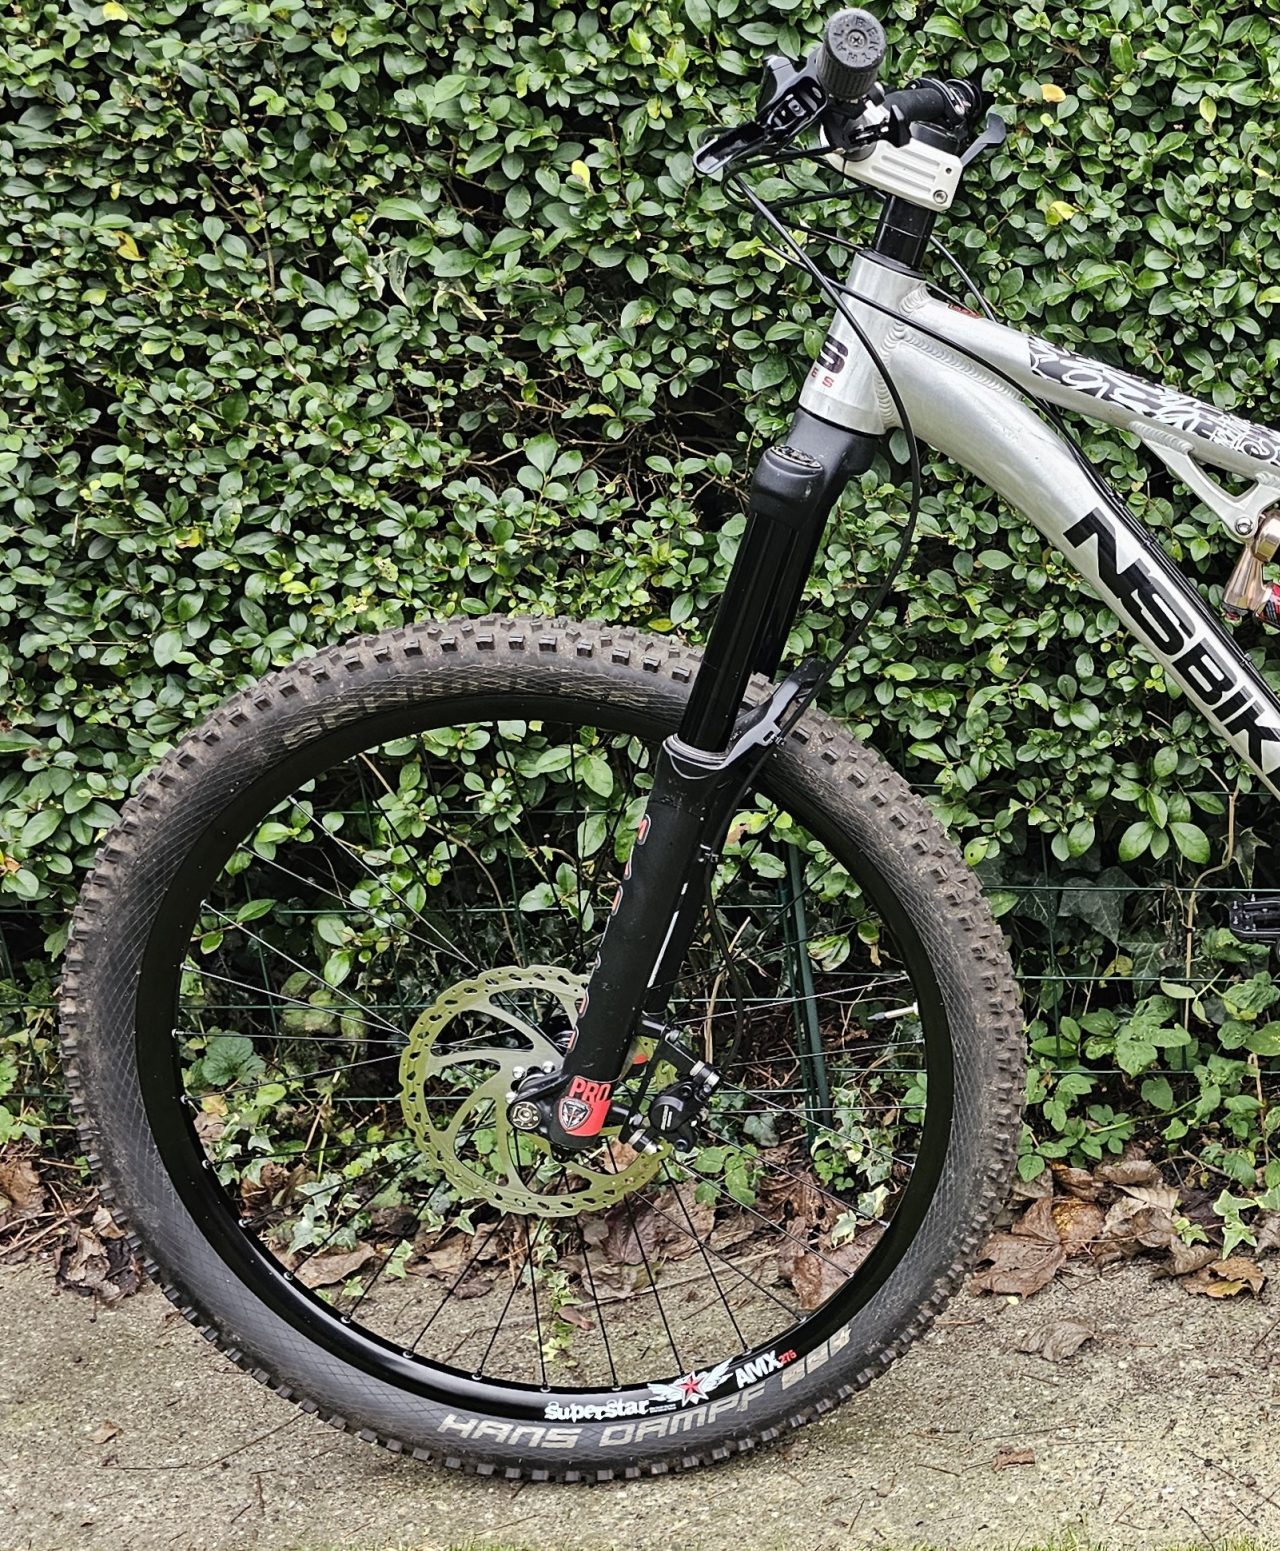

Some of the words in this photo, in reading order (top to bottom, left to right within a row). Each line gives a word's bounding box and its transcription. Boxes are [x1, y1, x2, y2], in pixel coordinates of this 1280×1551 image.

[569, 1077, 611, 1102] PRO
[437, 1414, 583, 1449] HANS
[599, 1381, 766, 1447] DAMPF
